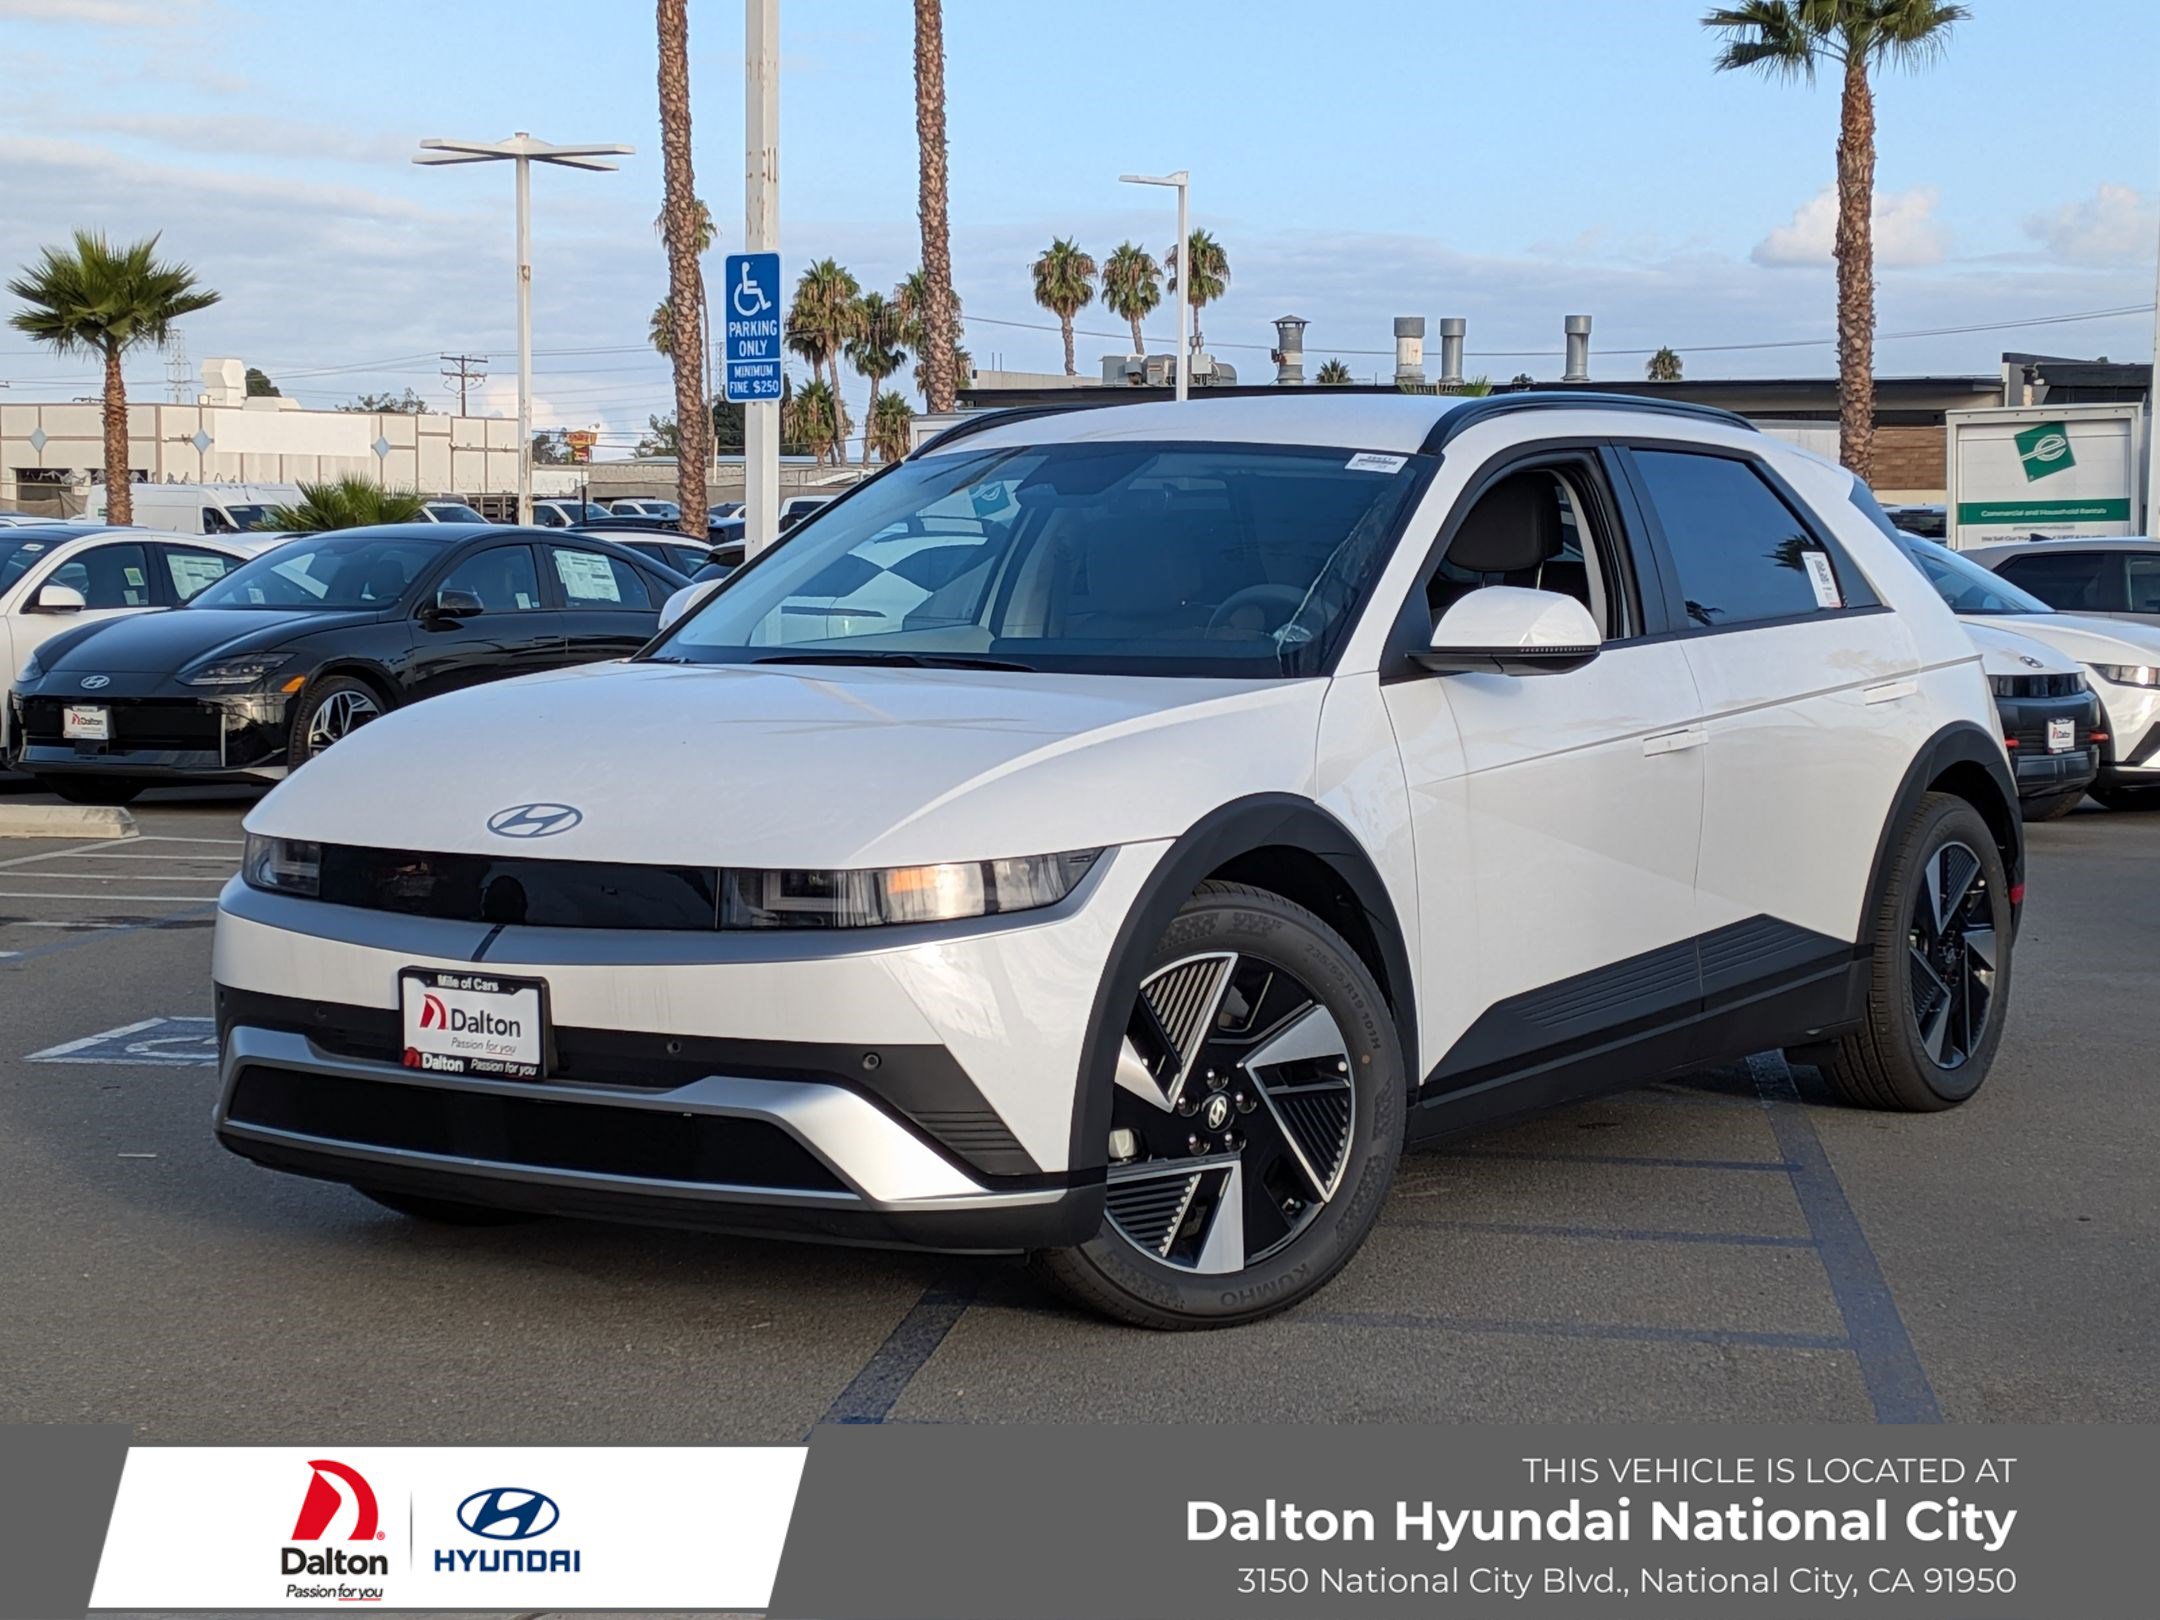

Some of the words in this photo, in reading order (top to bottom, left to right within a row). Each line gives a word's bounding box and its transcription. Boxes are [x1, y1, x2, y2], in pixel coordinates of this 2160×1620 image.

[728, 320, 778, 338] PARKING
[738, 339, 768, 357] ONLY
[734, 364, 774, 378] MINIMUM
[729, 381, 749, 394] FINE
[752, 380, 779, 393] $250
[437, 974, 460, 988] Mile
[461, 977, 472, 989] of
[473, 978, 500, 992] Cars
[451, 1008, 521, 1038] Dalton
[451, 1037, 484, 1050] Passion
[485, 1039, 498, 1053] for
[499, 1044, 517, 1054] you
[422, 1053, 464, 1072] Dalton
[471, 1059, 504, 1073] Passion
[504, 1062, 520, 1075] for
[519, 1064, 537, 1077] you
[1220, 1262, 1311, 1306] KUMHO
